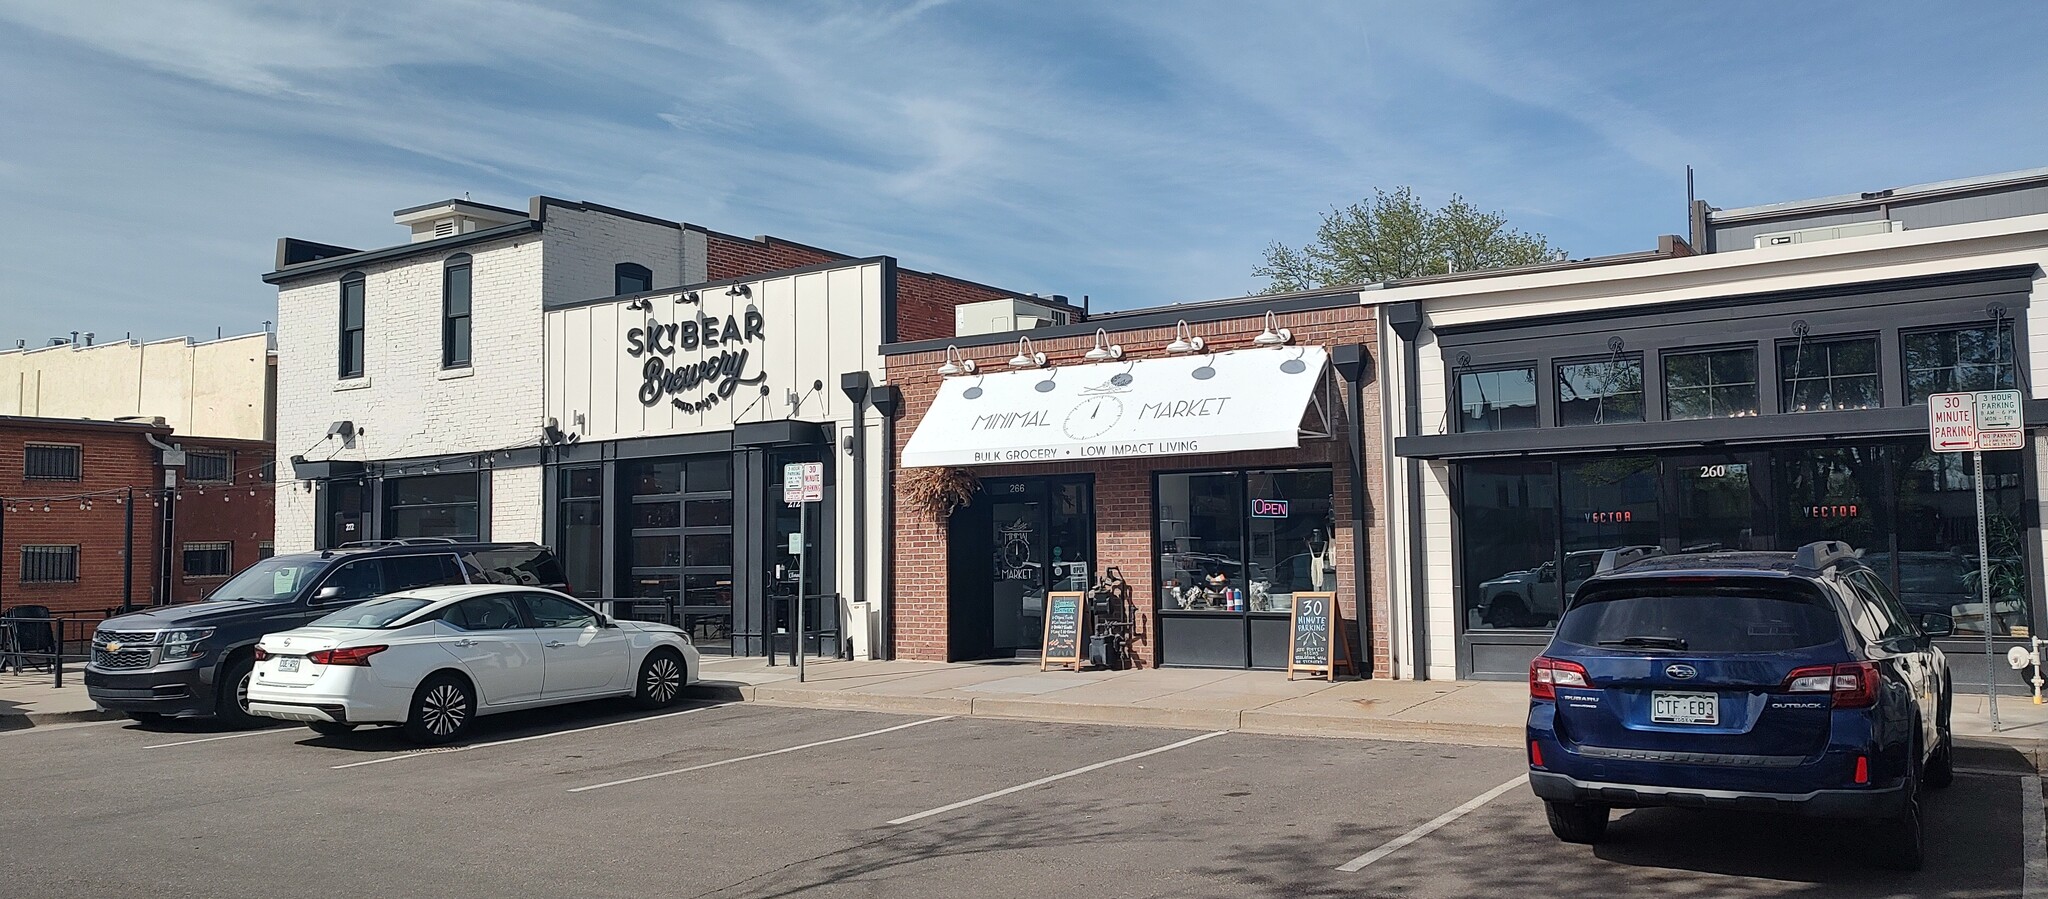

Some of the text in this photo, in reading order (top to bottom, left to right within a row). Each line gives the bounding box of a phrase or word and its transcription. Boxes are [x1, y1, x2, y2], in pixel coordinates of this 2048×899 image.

[627, 311, 765, 357] SKYBEAR
[639, 348, 767, 406] Brewery
[1944, 396, 1960, 408] 30
[971, 396, 1231, 430] MINIMAL MARKET
[1936, 410, 1969, 422] MINUTE
[1935, 426, 1973, 438] PARKING
[1080, 440, 1198, 456] LOW IMPACT LIVING
[974, 448, 1057, 461] BULK GROCERY
[808, 465, 817, 473] 30
[1700, 464, 1725, 478] 260
[1009, 483, 1025, 493] 266
[1254, 498, 1286, 514] OPEN
[1803, 505, 1857, 518] VECTOR
[1584, 511, 1631, 523] VECTOR
[1001, 568, 1033, 580] MARKET
[1303, 600, 1322, 616] 30
[1297, 616, 1326, 624] MINUTE
[1297, 624, 1326, 632] PARKING
